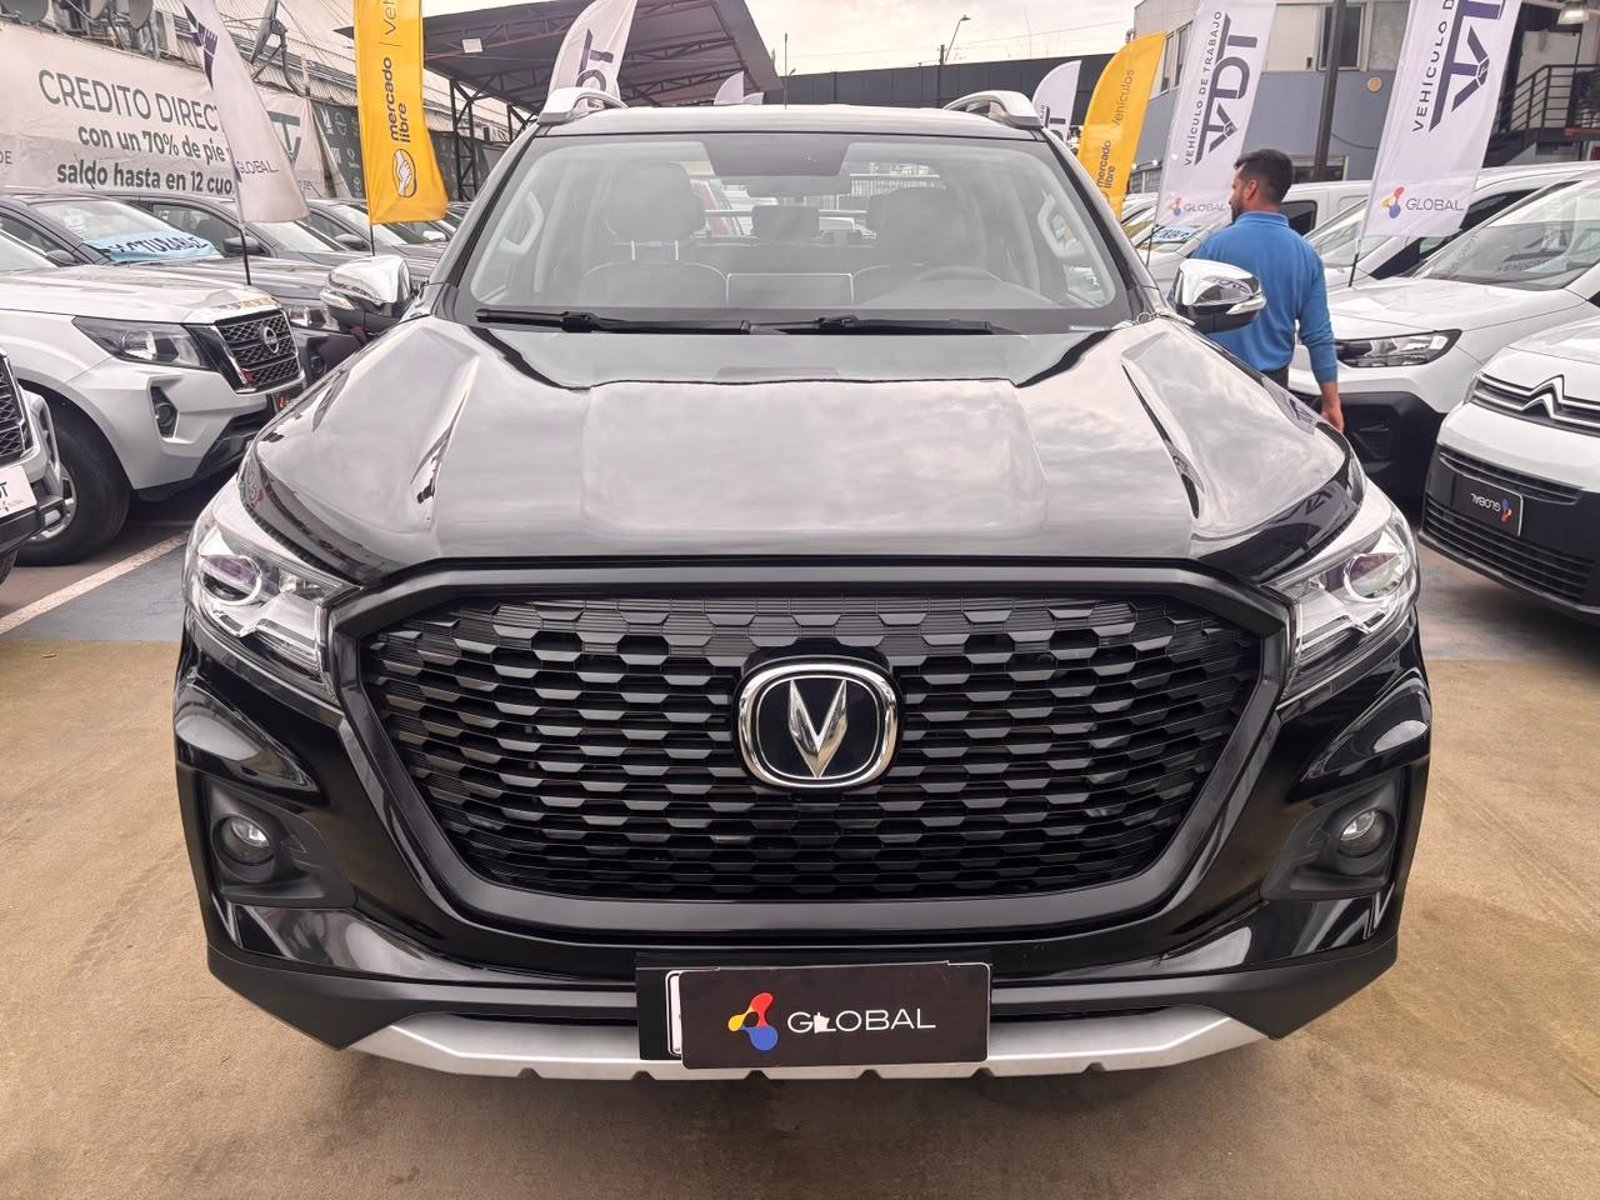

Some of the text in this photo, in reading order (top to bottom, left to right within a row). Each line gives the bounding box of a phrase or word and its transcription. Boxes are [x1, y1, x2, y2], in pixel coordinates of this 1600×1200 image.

[1199, 78, 1209, 95] DE
[1204, 11, 1222, 74] TRABAJO
[38, 69, 219, 132] CREDITO DIREC
[382, 56, 400, 142] mercado
[398, 103, 411, 143] libre
[78, 125, 225, 166] con un 70% de pie
[57, 159, 235, 195] saldo hasta en 12 cuo
[1184, 202, 1226, 213] GLOBAL
[1405, 198, 1465, 211] GLOBAL
[1470, 492, 1501, 512] GLOBAL
[787, 1008, 936, 1034] GLOBAL
